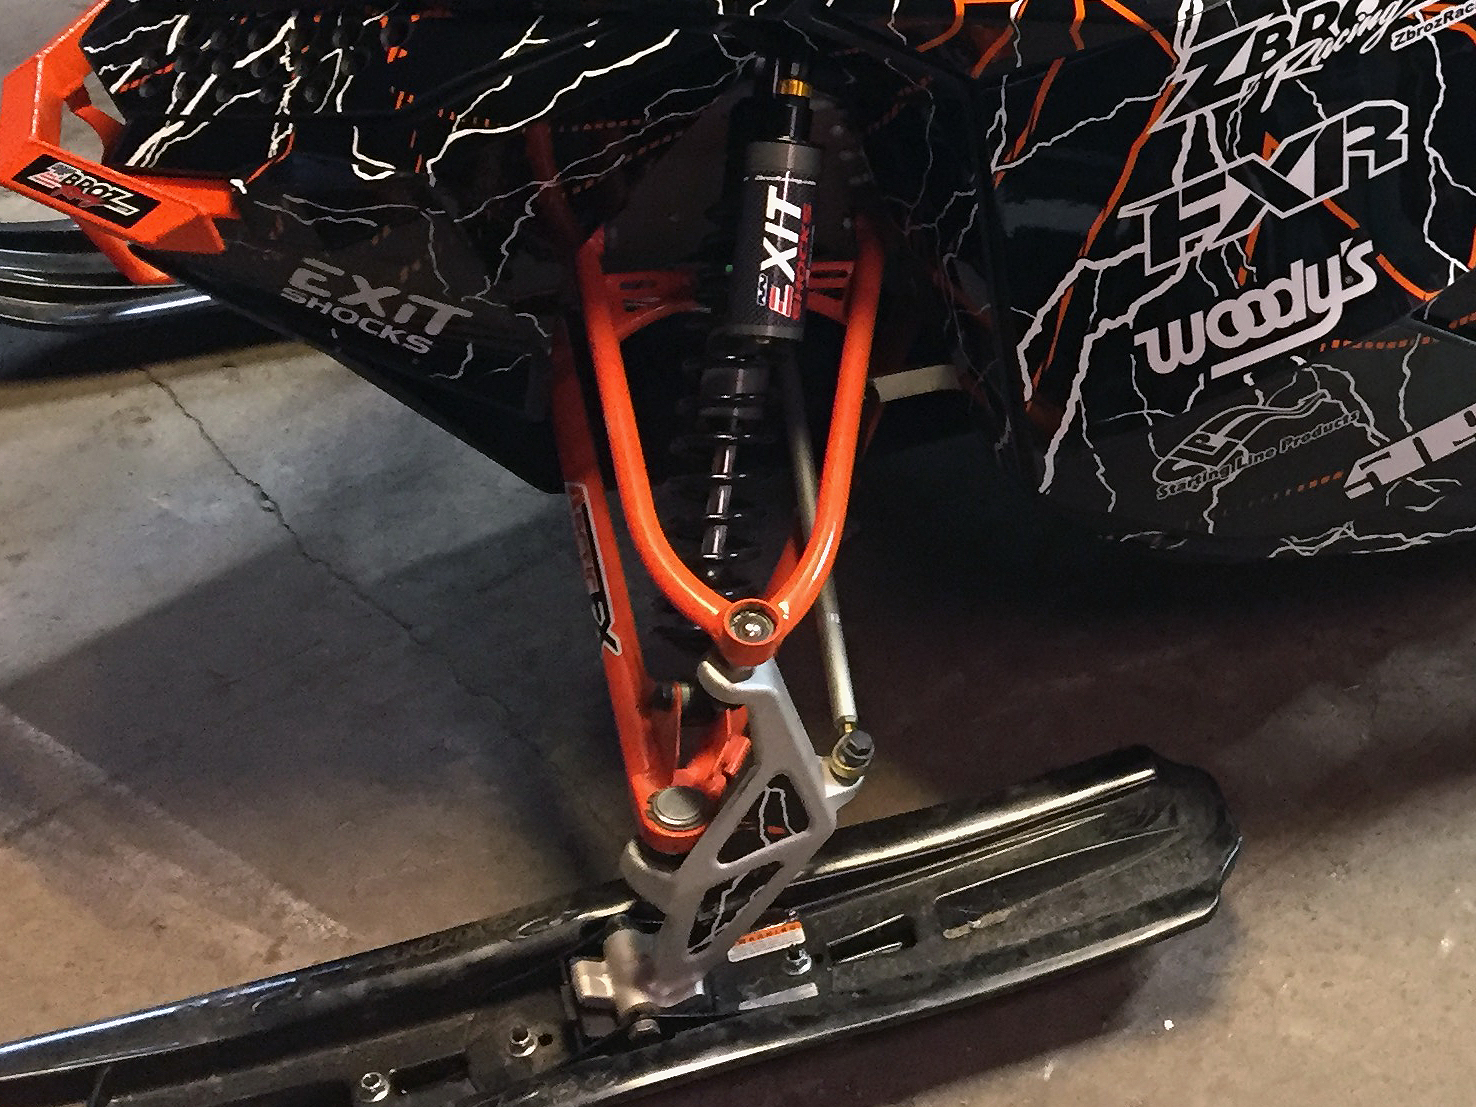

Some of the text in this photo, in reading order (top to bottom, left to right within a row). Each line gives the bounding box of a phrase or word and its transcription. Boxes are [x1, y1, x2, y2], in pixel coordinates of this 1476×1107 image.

[1117, 99, 1410, 277] FXR
[761, 185, 801, 318] EXIT
[279, 287, 434, 354] SHOCKS
[1156, 410, 1361, 500] Starting Line Products
